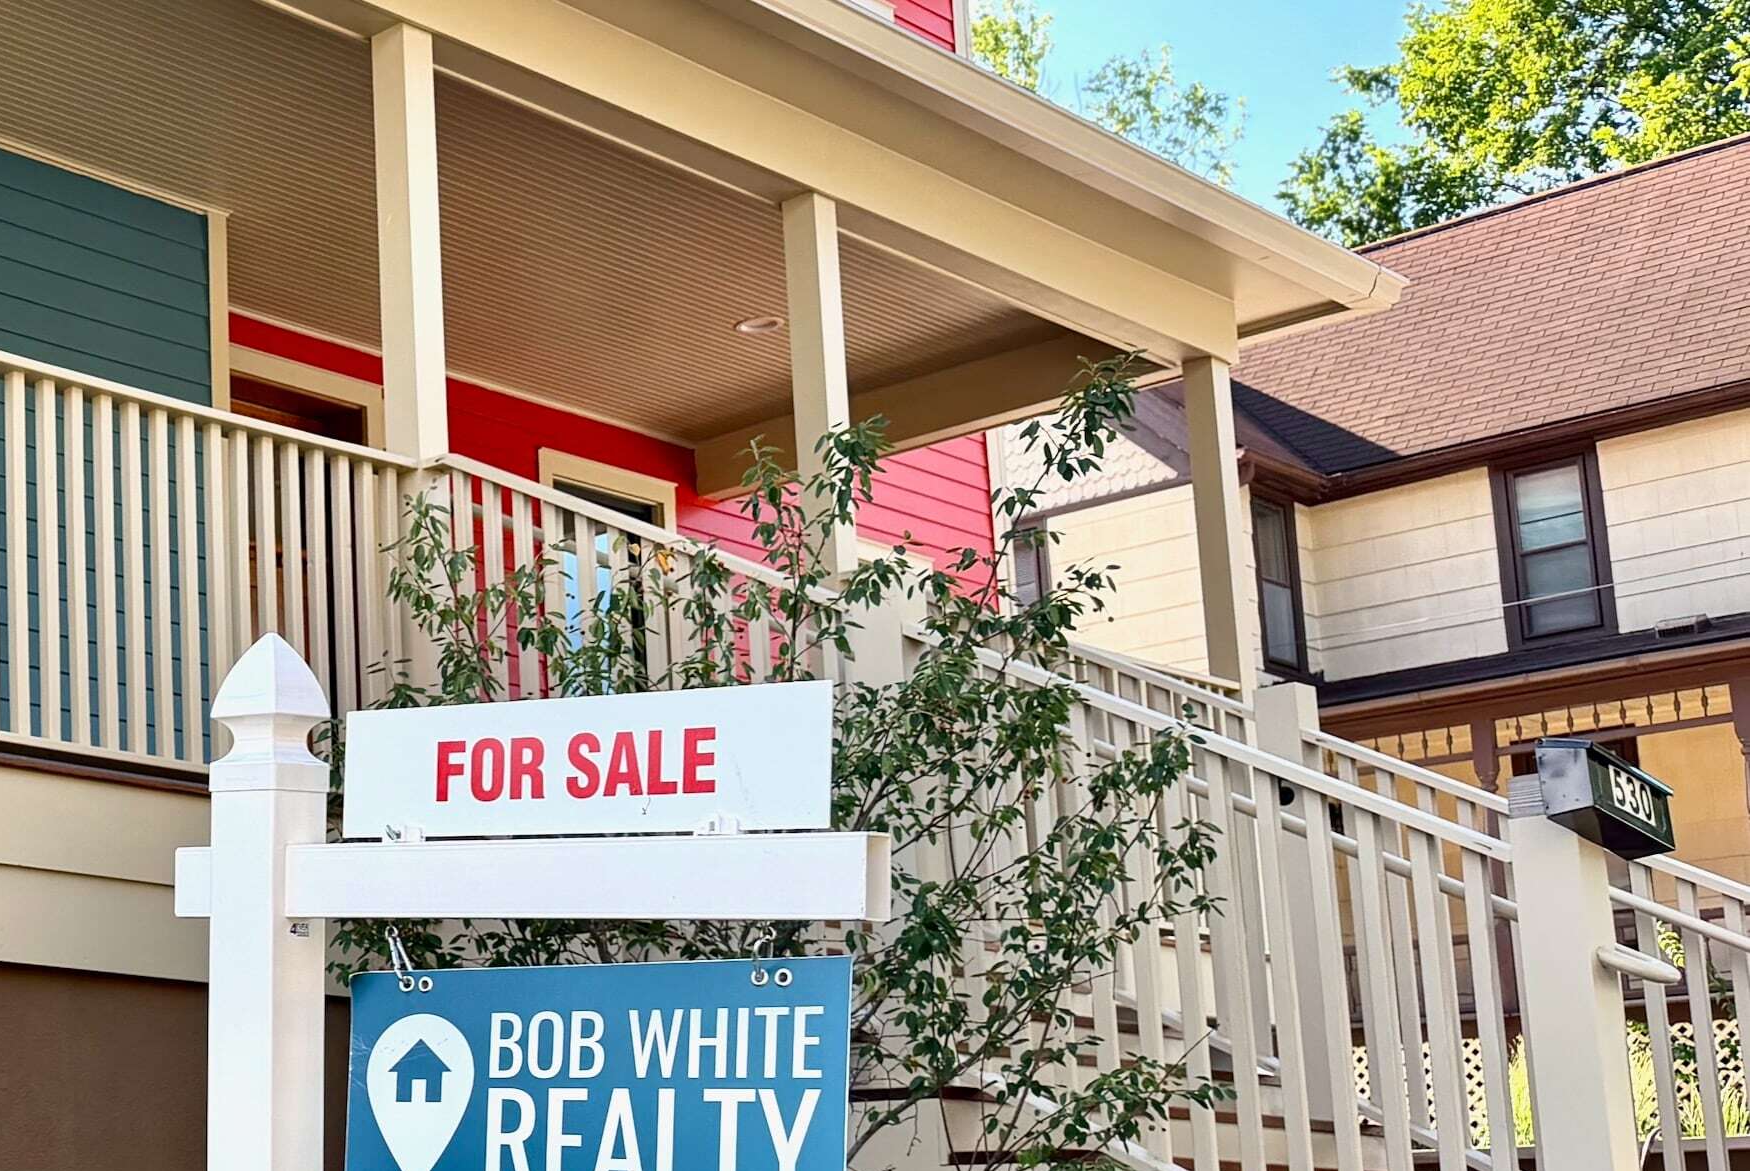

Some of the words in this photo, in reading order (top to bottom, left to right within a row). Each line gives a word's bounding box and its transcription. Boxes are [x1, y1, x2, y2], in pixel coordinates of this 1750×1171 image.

[436, 737, 545, 802] FOR
[566, 727, 716, 799] SALE
[1614, 769, 1652, 822] 530
[489, 1011, 604, 1079] BOB
[629, 1006, 824, 1079] WHITE
